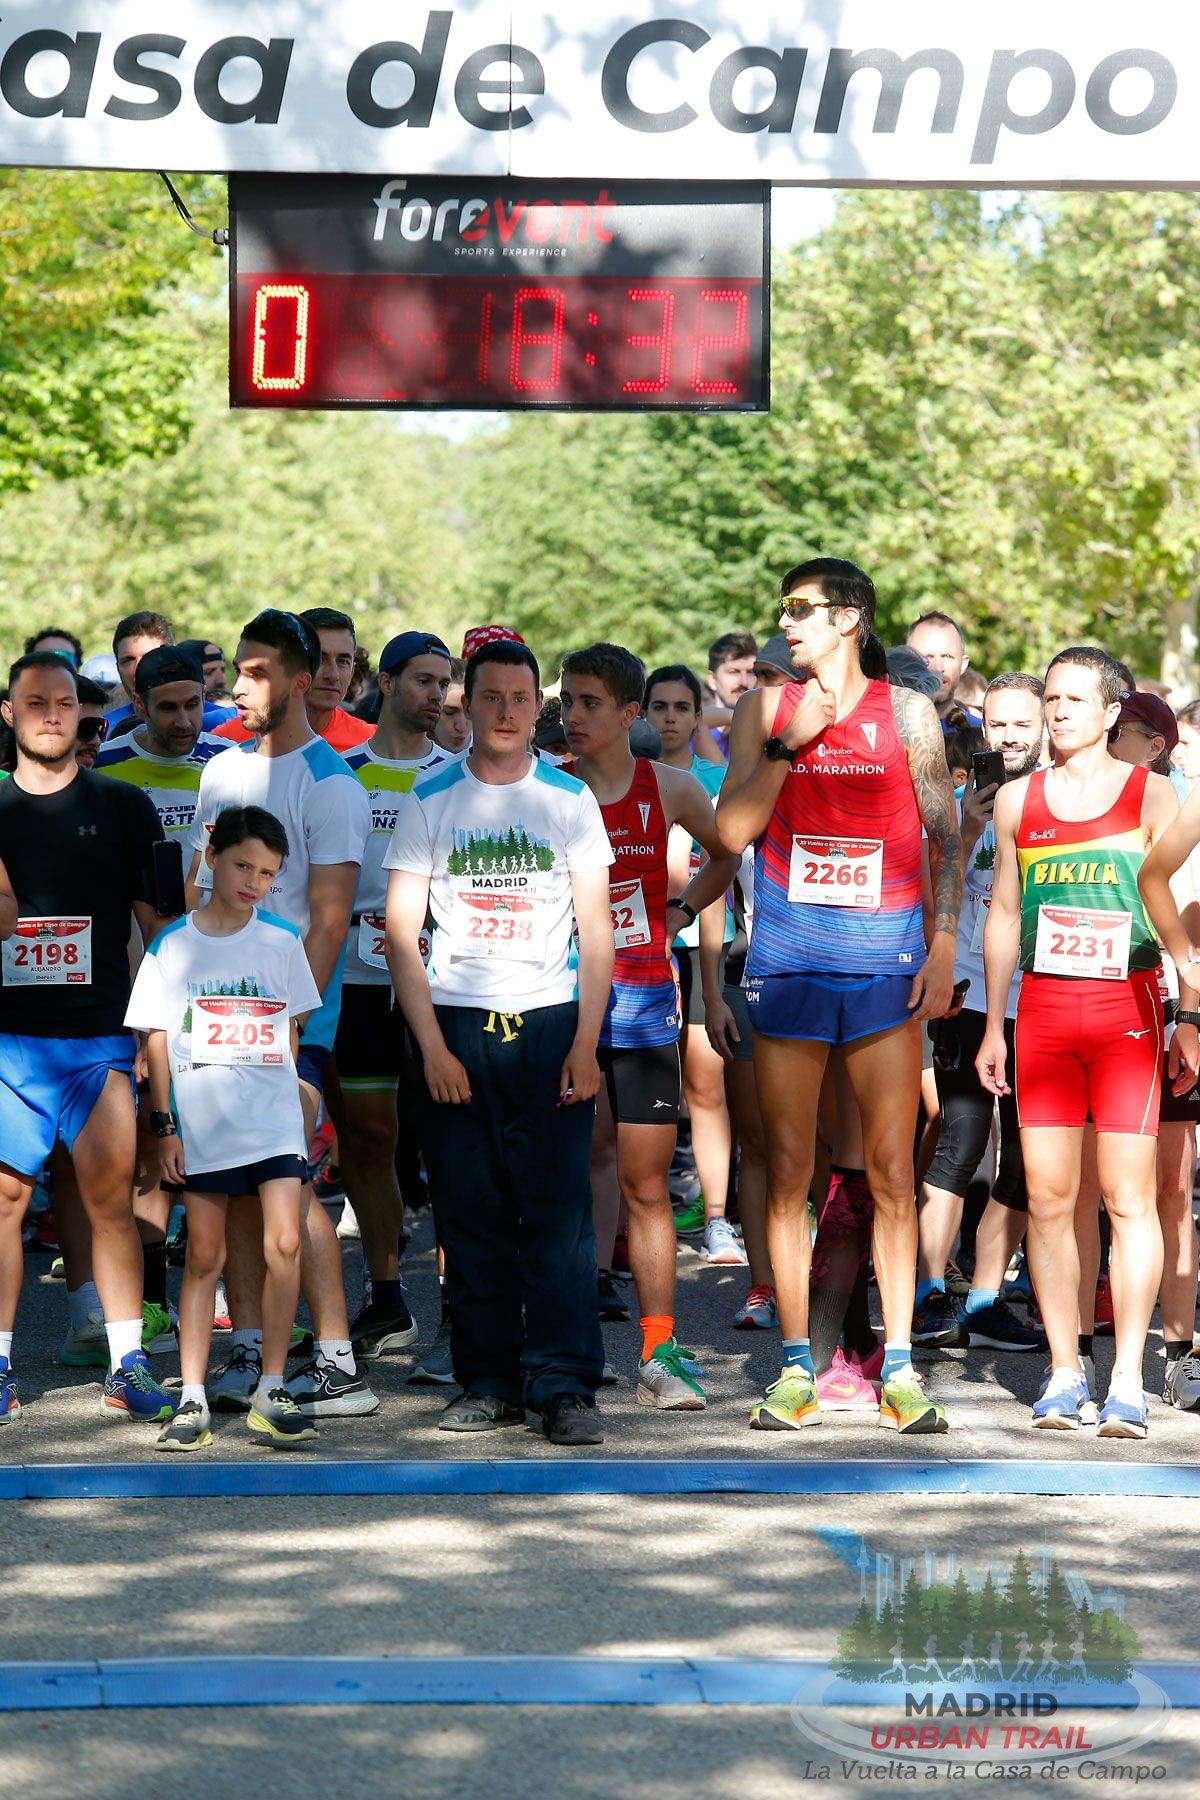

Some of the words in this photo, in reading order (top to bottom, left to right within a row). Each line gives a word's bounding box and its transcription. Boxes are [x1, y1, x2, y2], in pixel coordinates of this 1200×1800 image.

[0, 29, 295, 125] asa
[346, 11, 546, 131] de
[601, 18, 1178, 165] Campo
[373, 180, 617, 243] forevent
[454, 247, 495, 256] SPORTS
[502, 247, 567, 257] EXPERIENCE
[813, 764, 885, 775] MARATHON
[157, 804, 196, 813] AZUE
[607, 829, 629, 840] quiber
[611, 845, 654, 856] RATHON
[472, 877, 528, 888] MADRID
[803, 861, 868, 887] 2266
[1034, 862, 1120, 886] BIKILA
[467, 916, 533, 941] 2238
[15, 943, 78, 966] 2198
[1050, 933, 1114, 960] 2231
[207, 1023, 275, 1046] 2205
